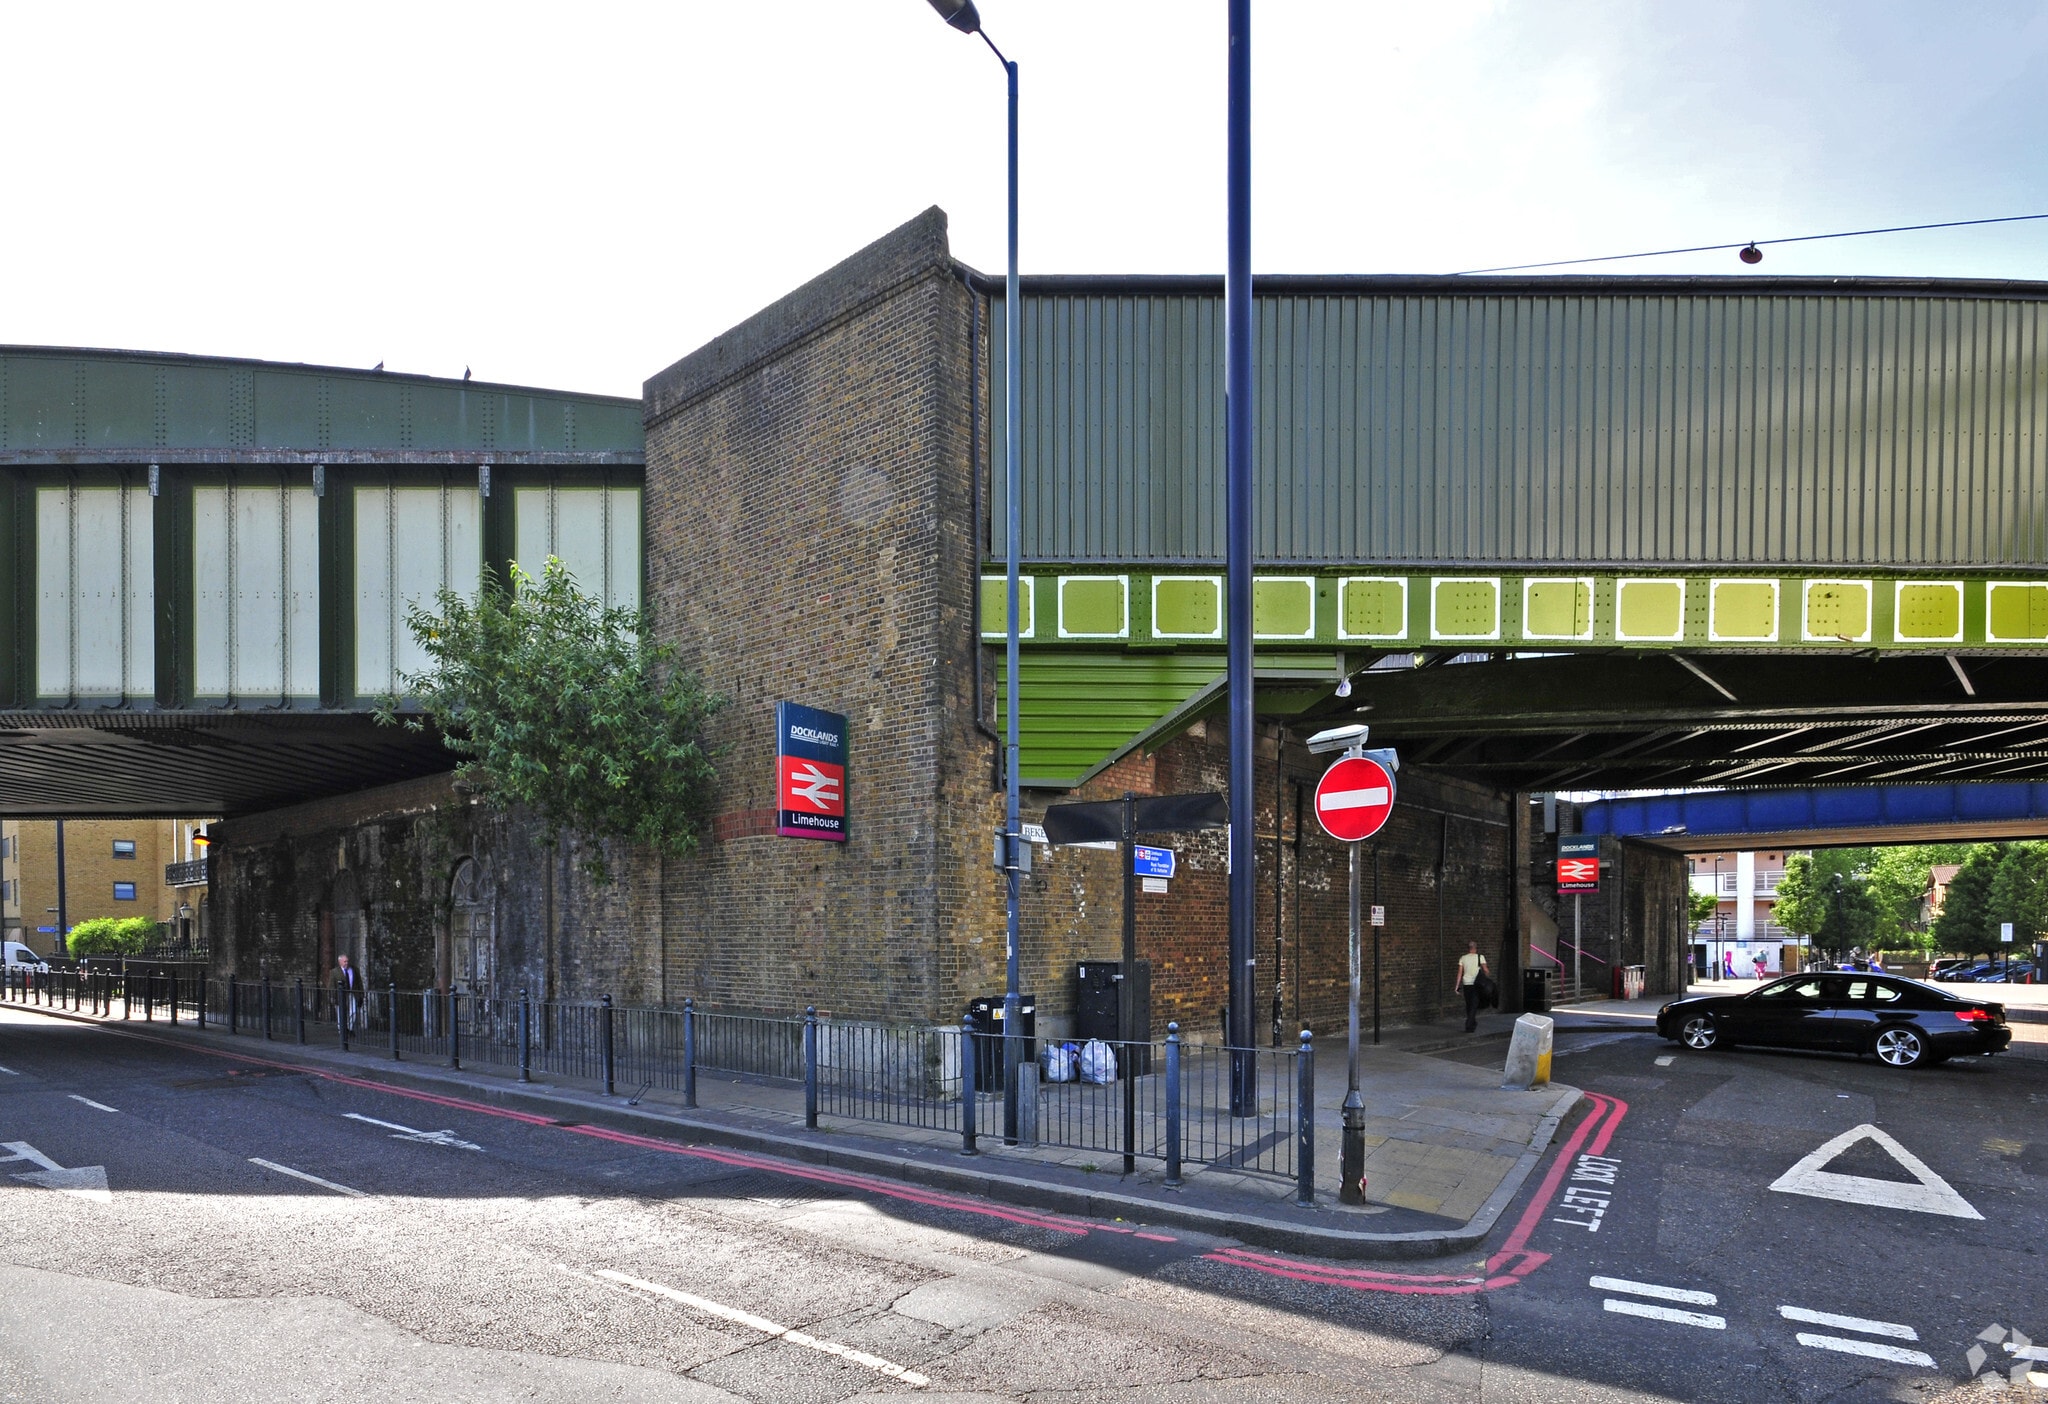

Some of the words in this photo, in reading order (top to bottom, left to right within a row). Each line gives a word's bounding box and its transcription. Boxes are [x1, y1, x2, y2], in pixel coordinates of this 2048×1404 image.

[791, 725, 838, 743] DOCKLANDS
[792, 813, 839, 829] Limehouse
[1024, 827, 1046, 837] BEKE
[1571, 1154, 1622, 1185] LOOK
[1553, 1187, 1612, 1232] LEFT
